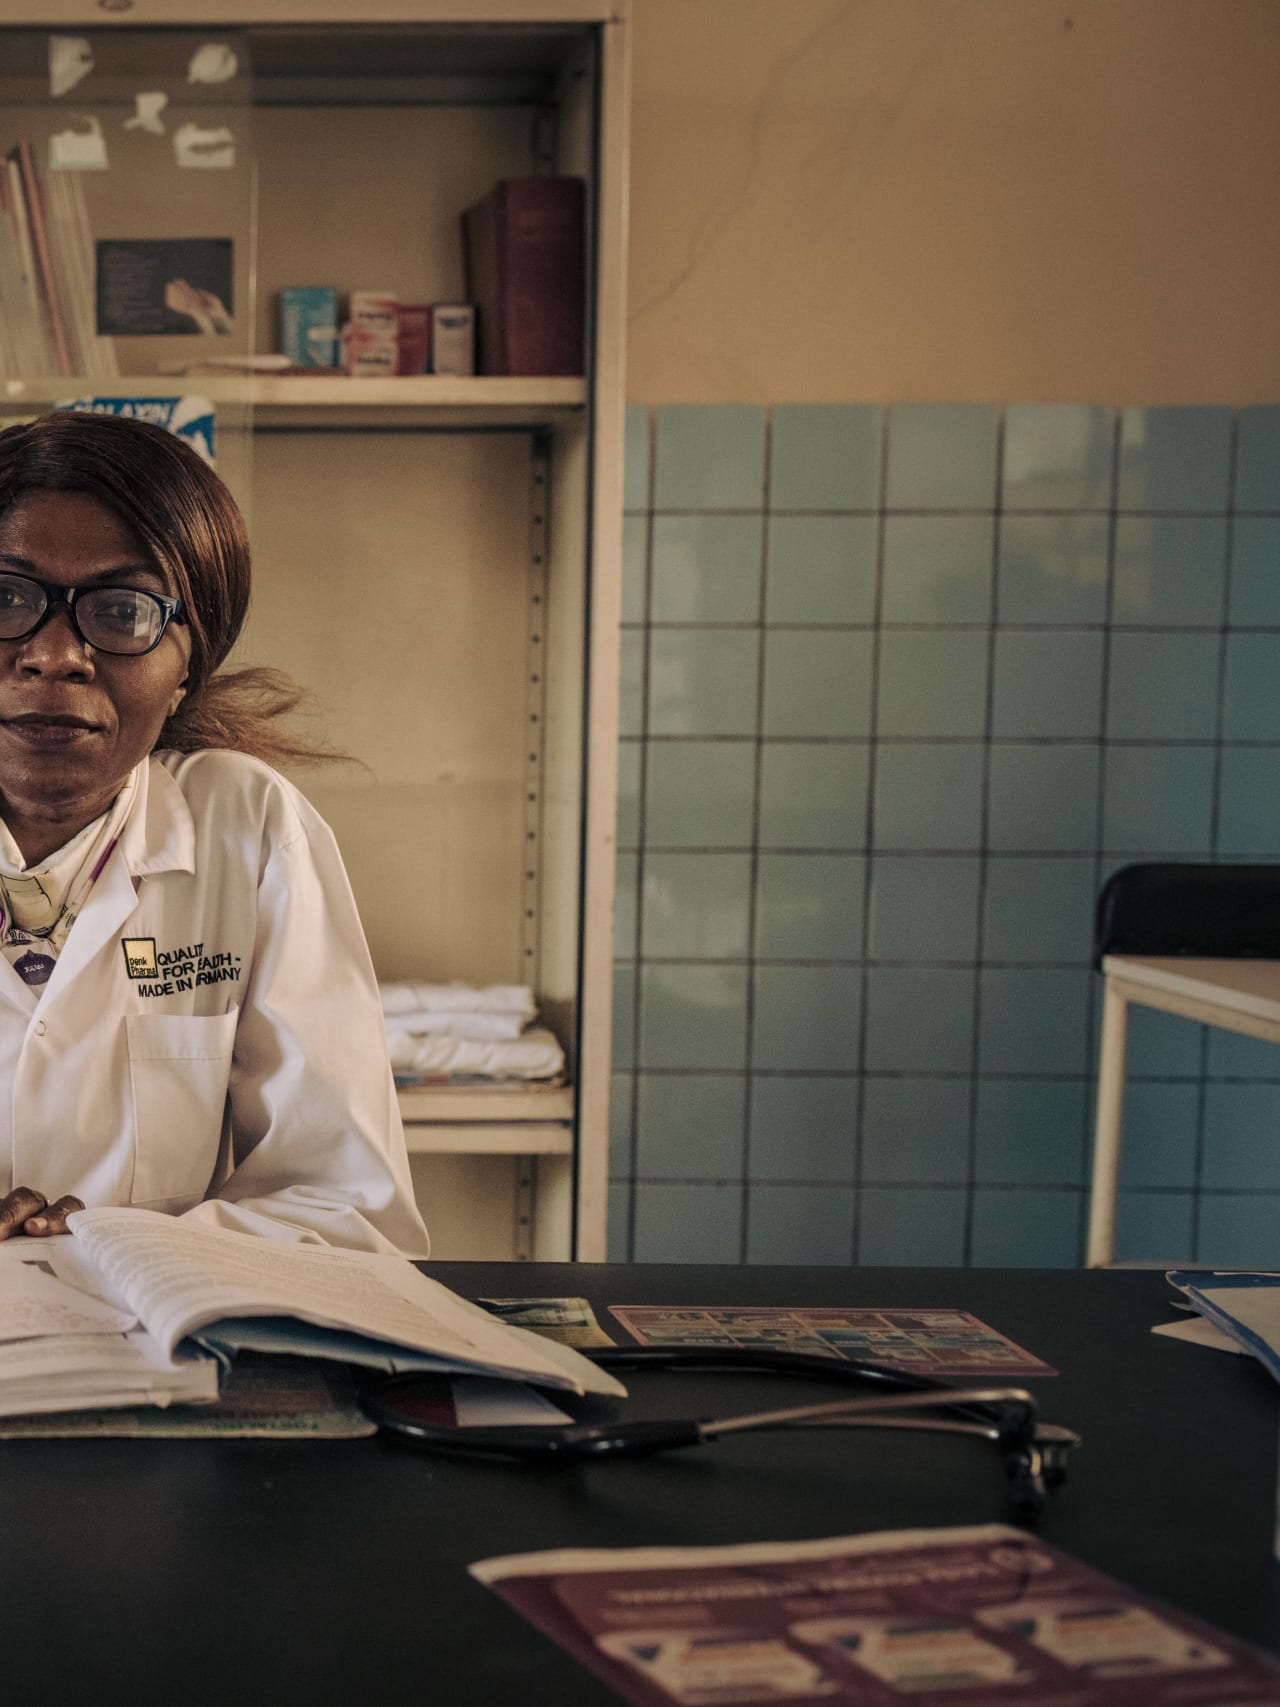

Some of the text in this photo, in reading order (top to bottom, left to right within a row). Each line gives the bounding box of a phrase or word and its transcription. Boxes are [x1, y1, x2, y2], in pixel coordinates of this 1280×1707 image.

[163, 961, 195, 980] FOR
[138, 982, 175, 997] MADE
[176, 977, 193, 992] IN
